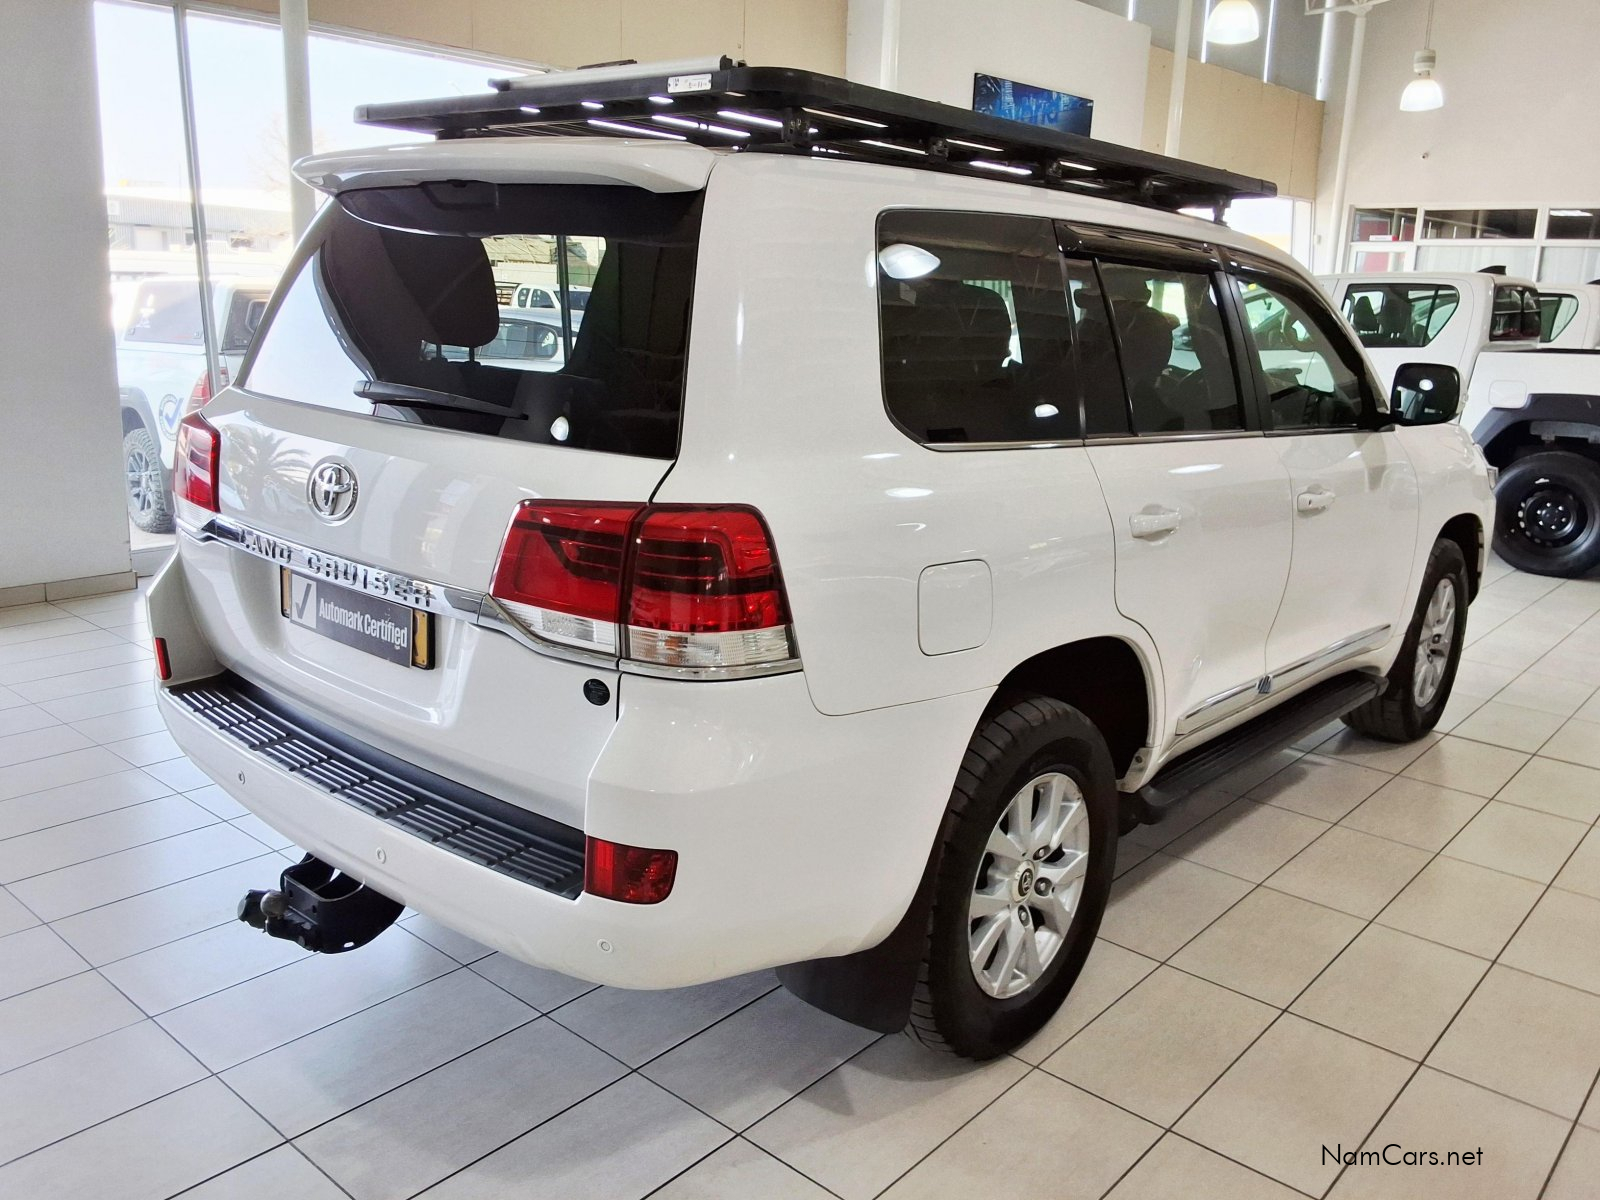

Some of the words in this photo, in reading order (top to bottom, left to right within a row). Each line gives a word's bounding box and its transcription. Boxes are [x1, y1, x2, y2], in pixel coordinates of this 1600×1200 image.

[239, 527, 293, 564] LAND
[307, 552, 432, 607] CRUISER
[318, 598, 364, 632] Automark
[364, 614, 408, 648] Certified
